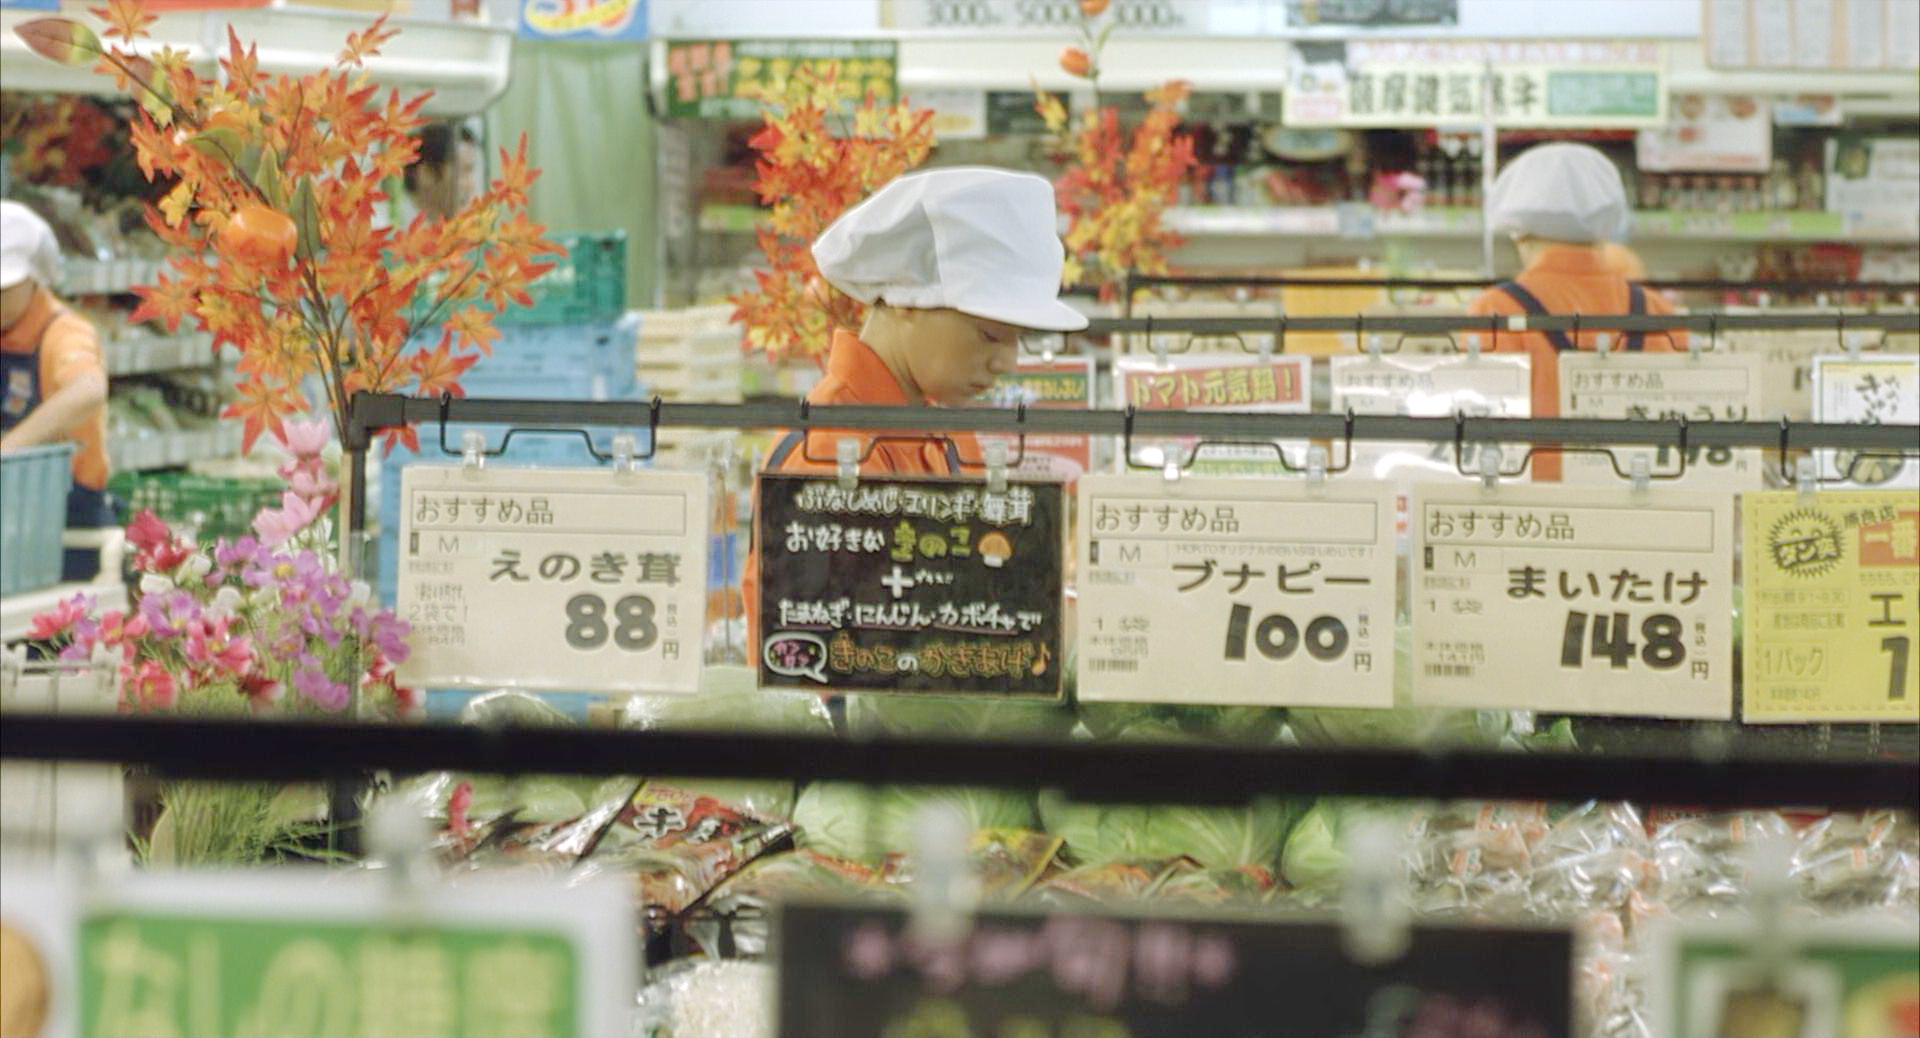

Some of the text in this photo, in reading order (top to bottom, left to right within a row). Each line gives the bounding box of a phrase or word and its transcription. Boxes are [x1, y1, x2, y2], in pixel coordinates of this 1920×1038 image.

[1574, 373, 1664, 390] おすすめ品
[415, 496, 555, 526] おすすめ品
[1095, 503, 1240, 533] おすすめ品
[1429, 509, 1575, 541] おすすめ品
[438, 536, 460, 553] M
[891, 519, 971, 561] きのこ
[1119, 544, 1142, 563] M
[489, 549, 682, 586] えのき茸
[1454, 552, 1477, 568] M
[1172, 559, 1372, 594] ブナピー
[1506, 565, 1709, 604] まいたけ
[564, 593, 659, 652] 88
[1224, 602, 1350, 662] 100
[662, 641, 680, 661] 円
[1560, 610, 1687, 670] 148
[1354, 652, 1372, 672] 円
[1691, 660, 1709, 680] 円
